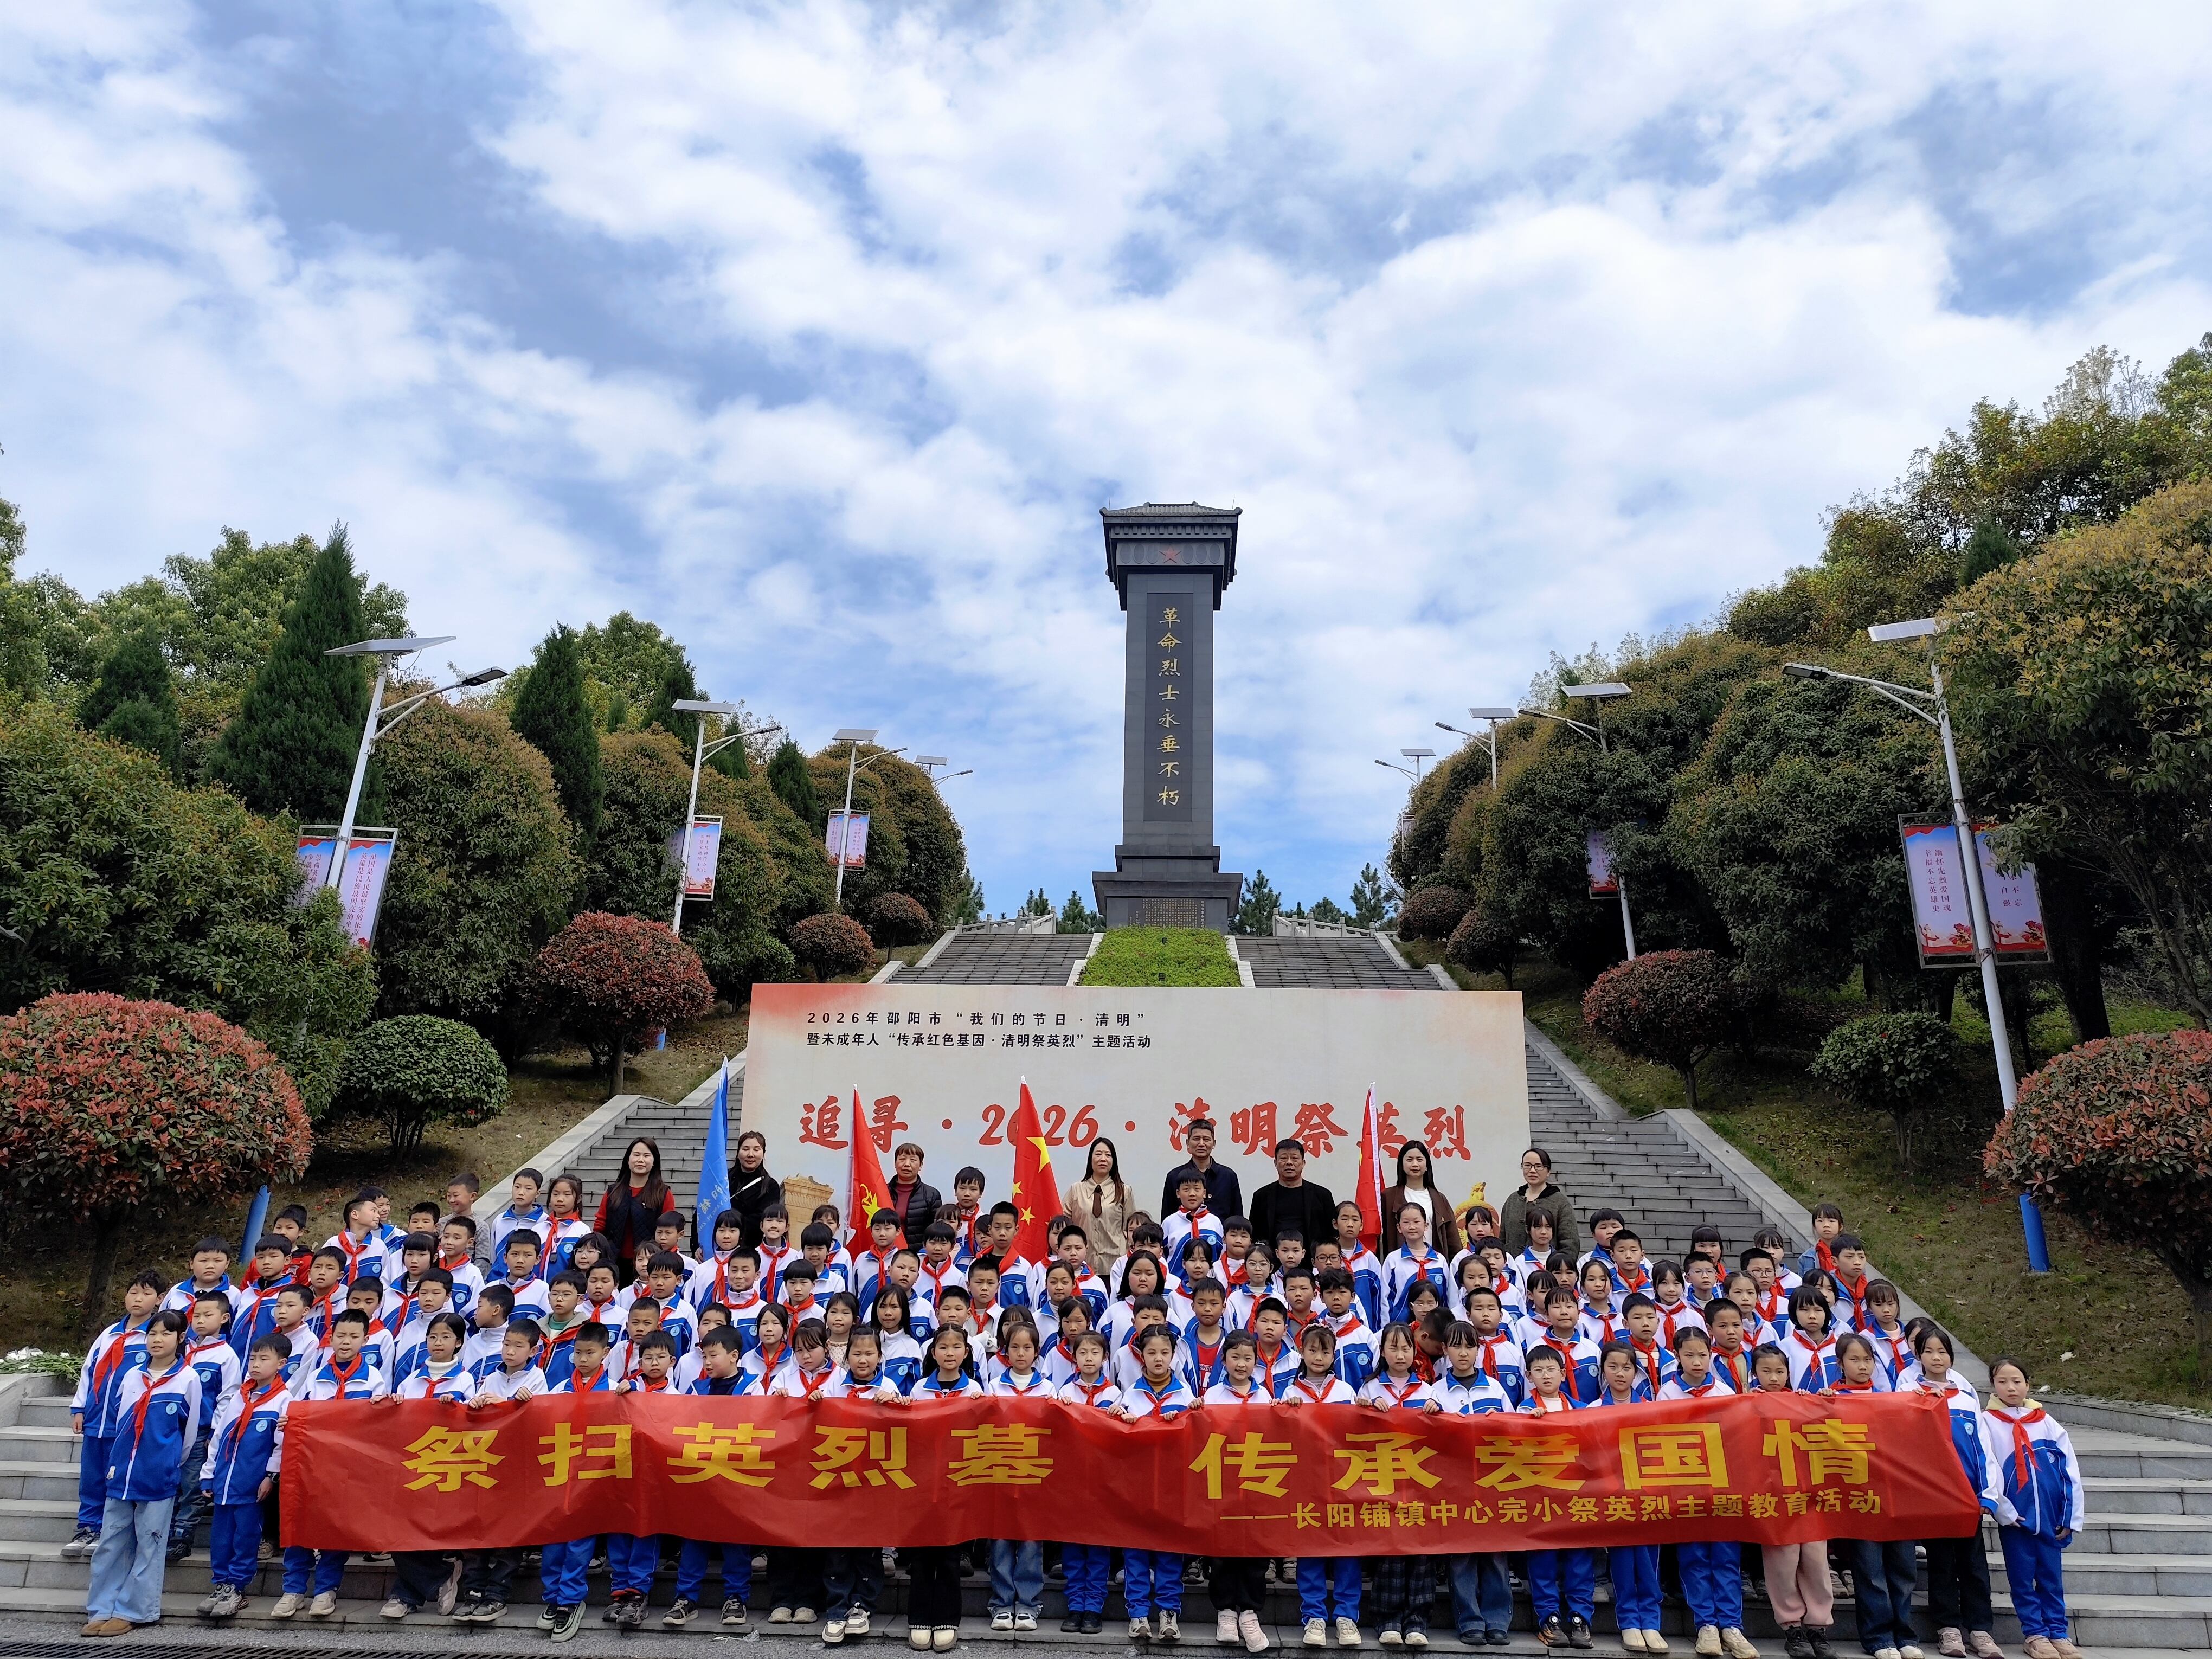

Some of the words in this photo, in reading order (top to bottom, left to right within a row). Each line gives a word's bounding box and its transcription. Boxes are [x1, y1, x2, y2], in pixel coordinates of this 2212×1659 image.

[1156, 607, 1181, 806] 革命烈士永垂不朽
[353, 852, 377, 937] 祖国是人民最坚实的依靠
[1925, 849, 1940, 912] 幸福不忘英雄史
[1934, 849, 1952, 912] 缅怀先烈爱国魂
[402, 1422, 1053, 1492] 祭扫英烈墓
[1188, 1418, 1876, 1499] 传承爱国情
